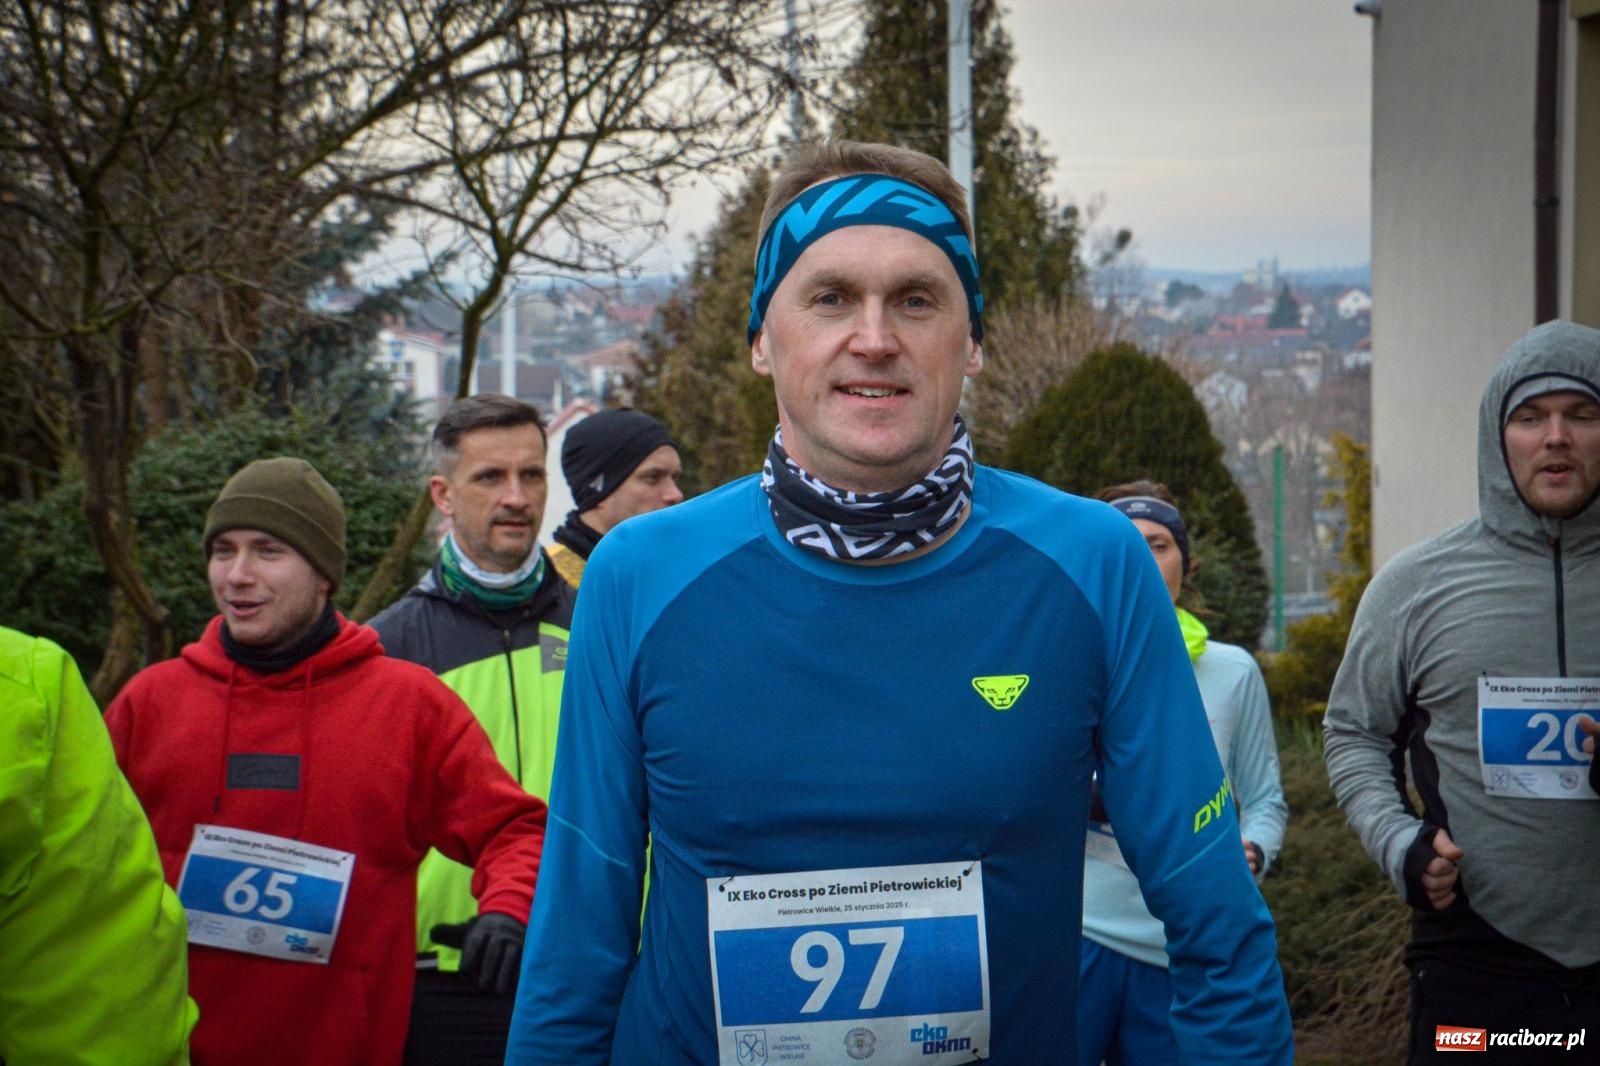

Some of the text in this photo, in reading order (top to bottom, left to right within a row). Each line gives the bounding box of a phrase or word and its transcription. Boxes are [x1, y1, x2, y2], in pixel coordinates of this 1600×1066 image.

[1541, 686, 1553, 695] po
[223, 866, 298, 920] 65
[727, 875, 962, 902] IX Eko Cross po Ziemi Pietrowickiej
[778, 905, 814, 916] Pietrowice
[844, 904, 853, 912] 25
[854, 902, 885, 913] stycznia
[885, 901, 904, 910] 2025
[790, 926, 905, 1014] 97
